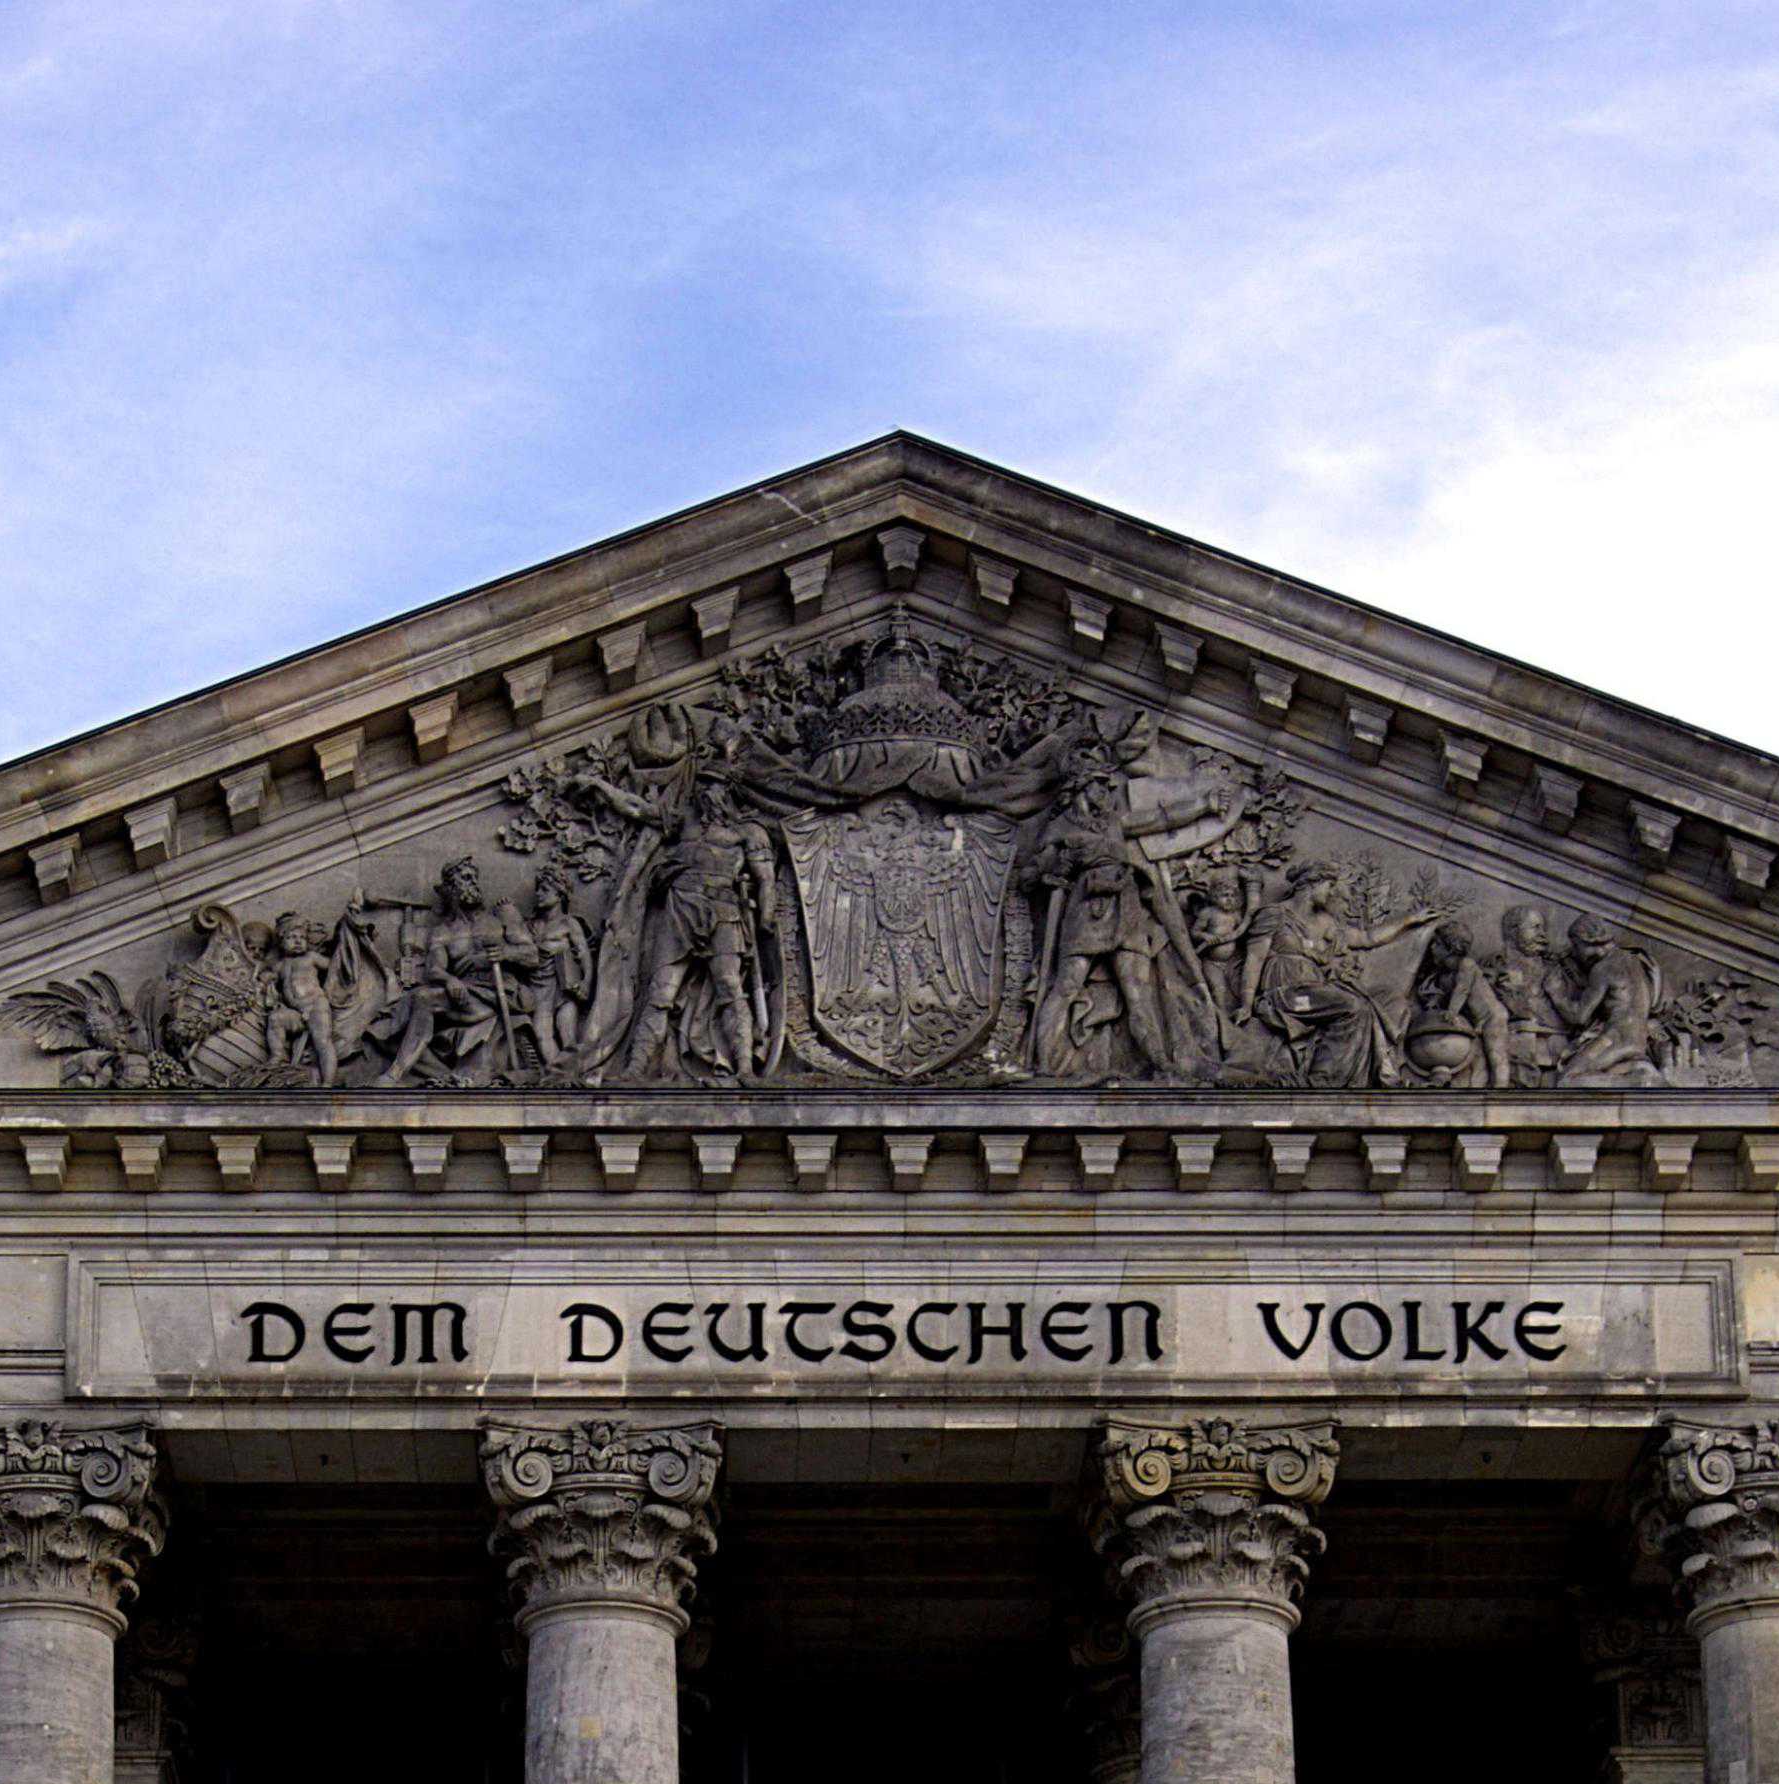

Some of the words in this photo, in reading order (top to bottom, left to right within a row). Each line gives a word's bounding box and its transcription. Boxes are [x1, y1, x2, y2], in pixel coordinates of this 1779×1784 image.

[239, 1301, 470, 1367] DEM
[559, 1299, 1164, 1366] DEUTSCHEN
[1256, 1300, 1568, 1365] VOLKE
